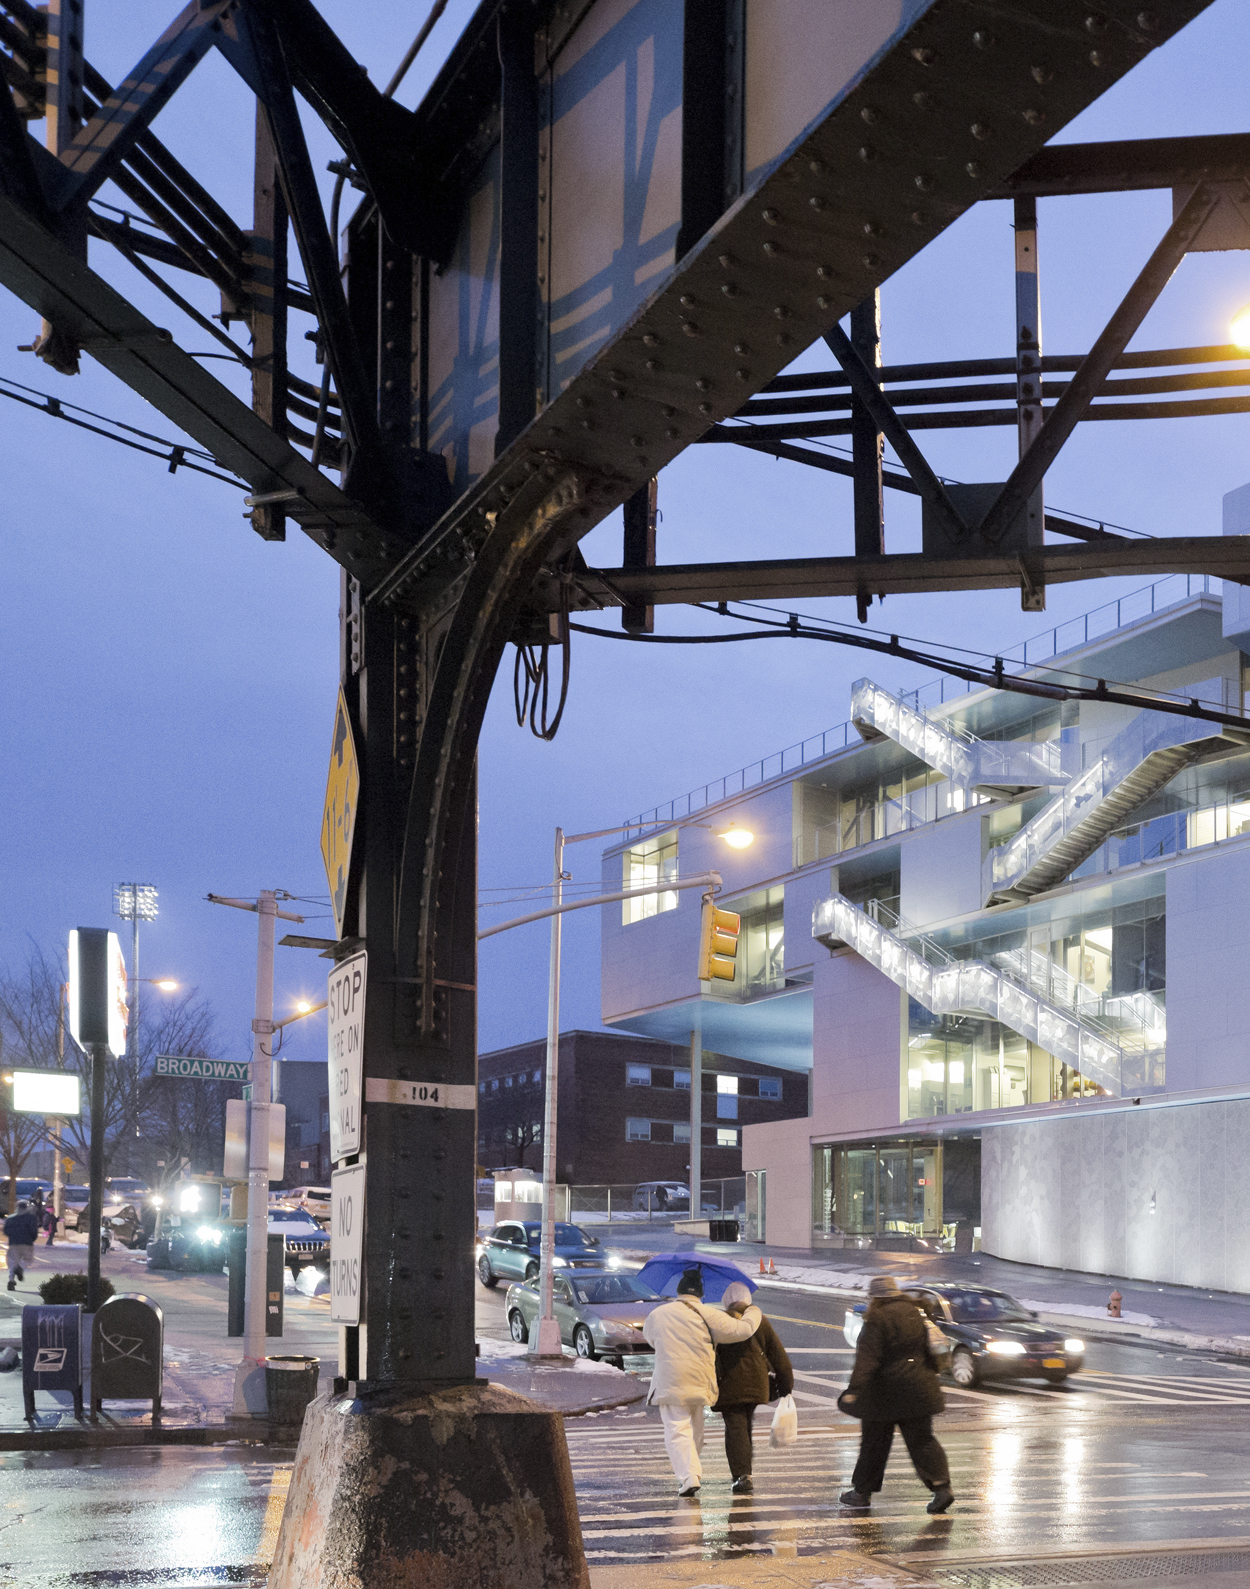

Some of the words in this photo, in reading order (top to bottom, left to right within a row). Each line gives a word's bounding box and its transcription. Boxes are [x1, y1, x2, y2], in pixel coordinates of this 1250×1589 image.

[330, 969, 362, 1026] STOP
[347, 1022, 360, 1054] ON
[157, 1058, 247, 1079] BROADWAY
[412, 1086, 439, 1103] 104
[339, 1195, 353, 1238] NO
[332, 1257, 358, 1297] TURNS
